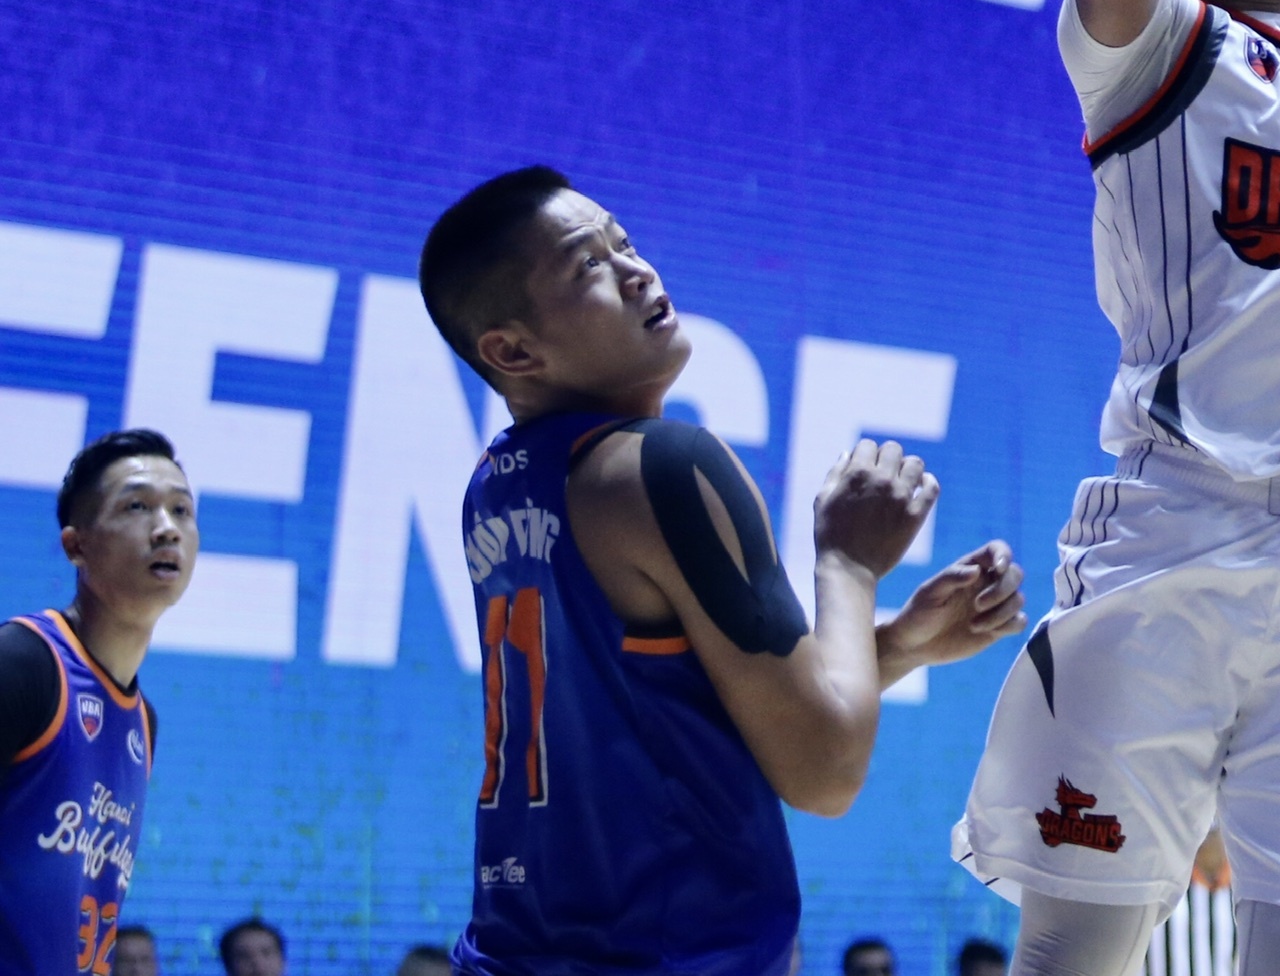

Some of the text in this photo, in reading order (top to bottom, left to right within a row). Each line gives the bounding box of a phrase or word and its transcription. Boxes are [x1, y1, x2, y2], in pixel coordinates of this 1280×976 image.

[480, 587, 548, 809] 11
[88, 781, 135, 825] Hanoi
[77, 894, 118, 976] 32
